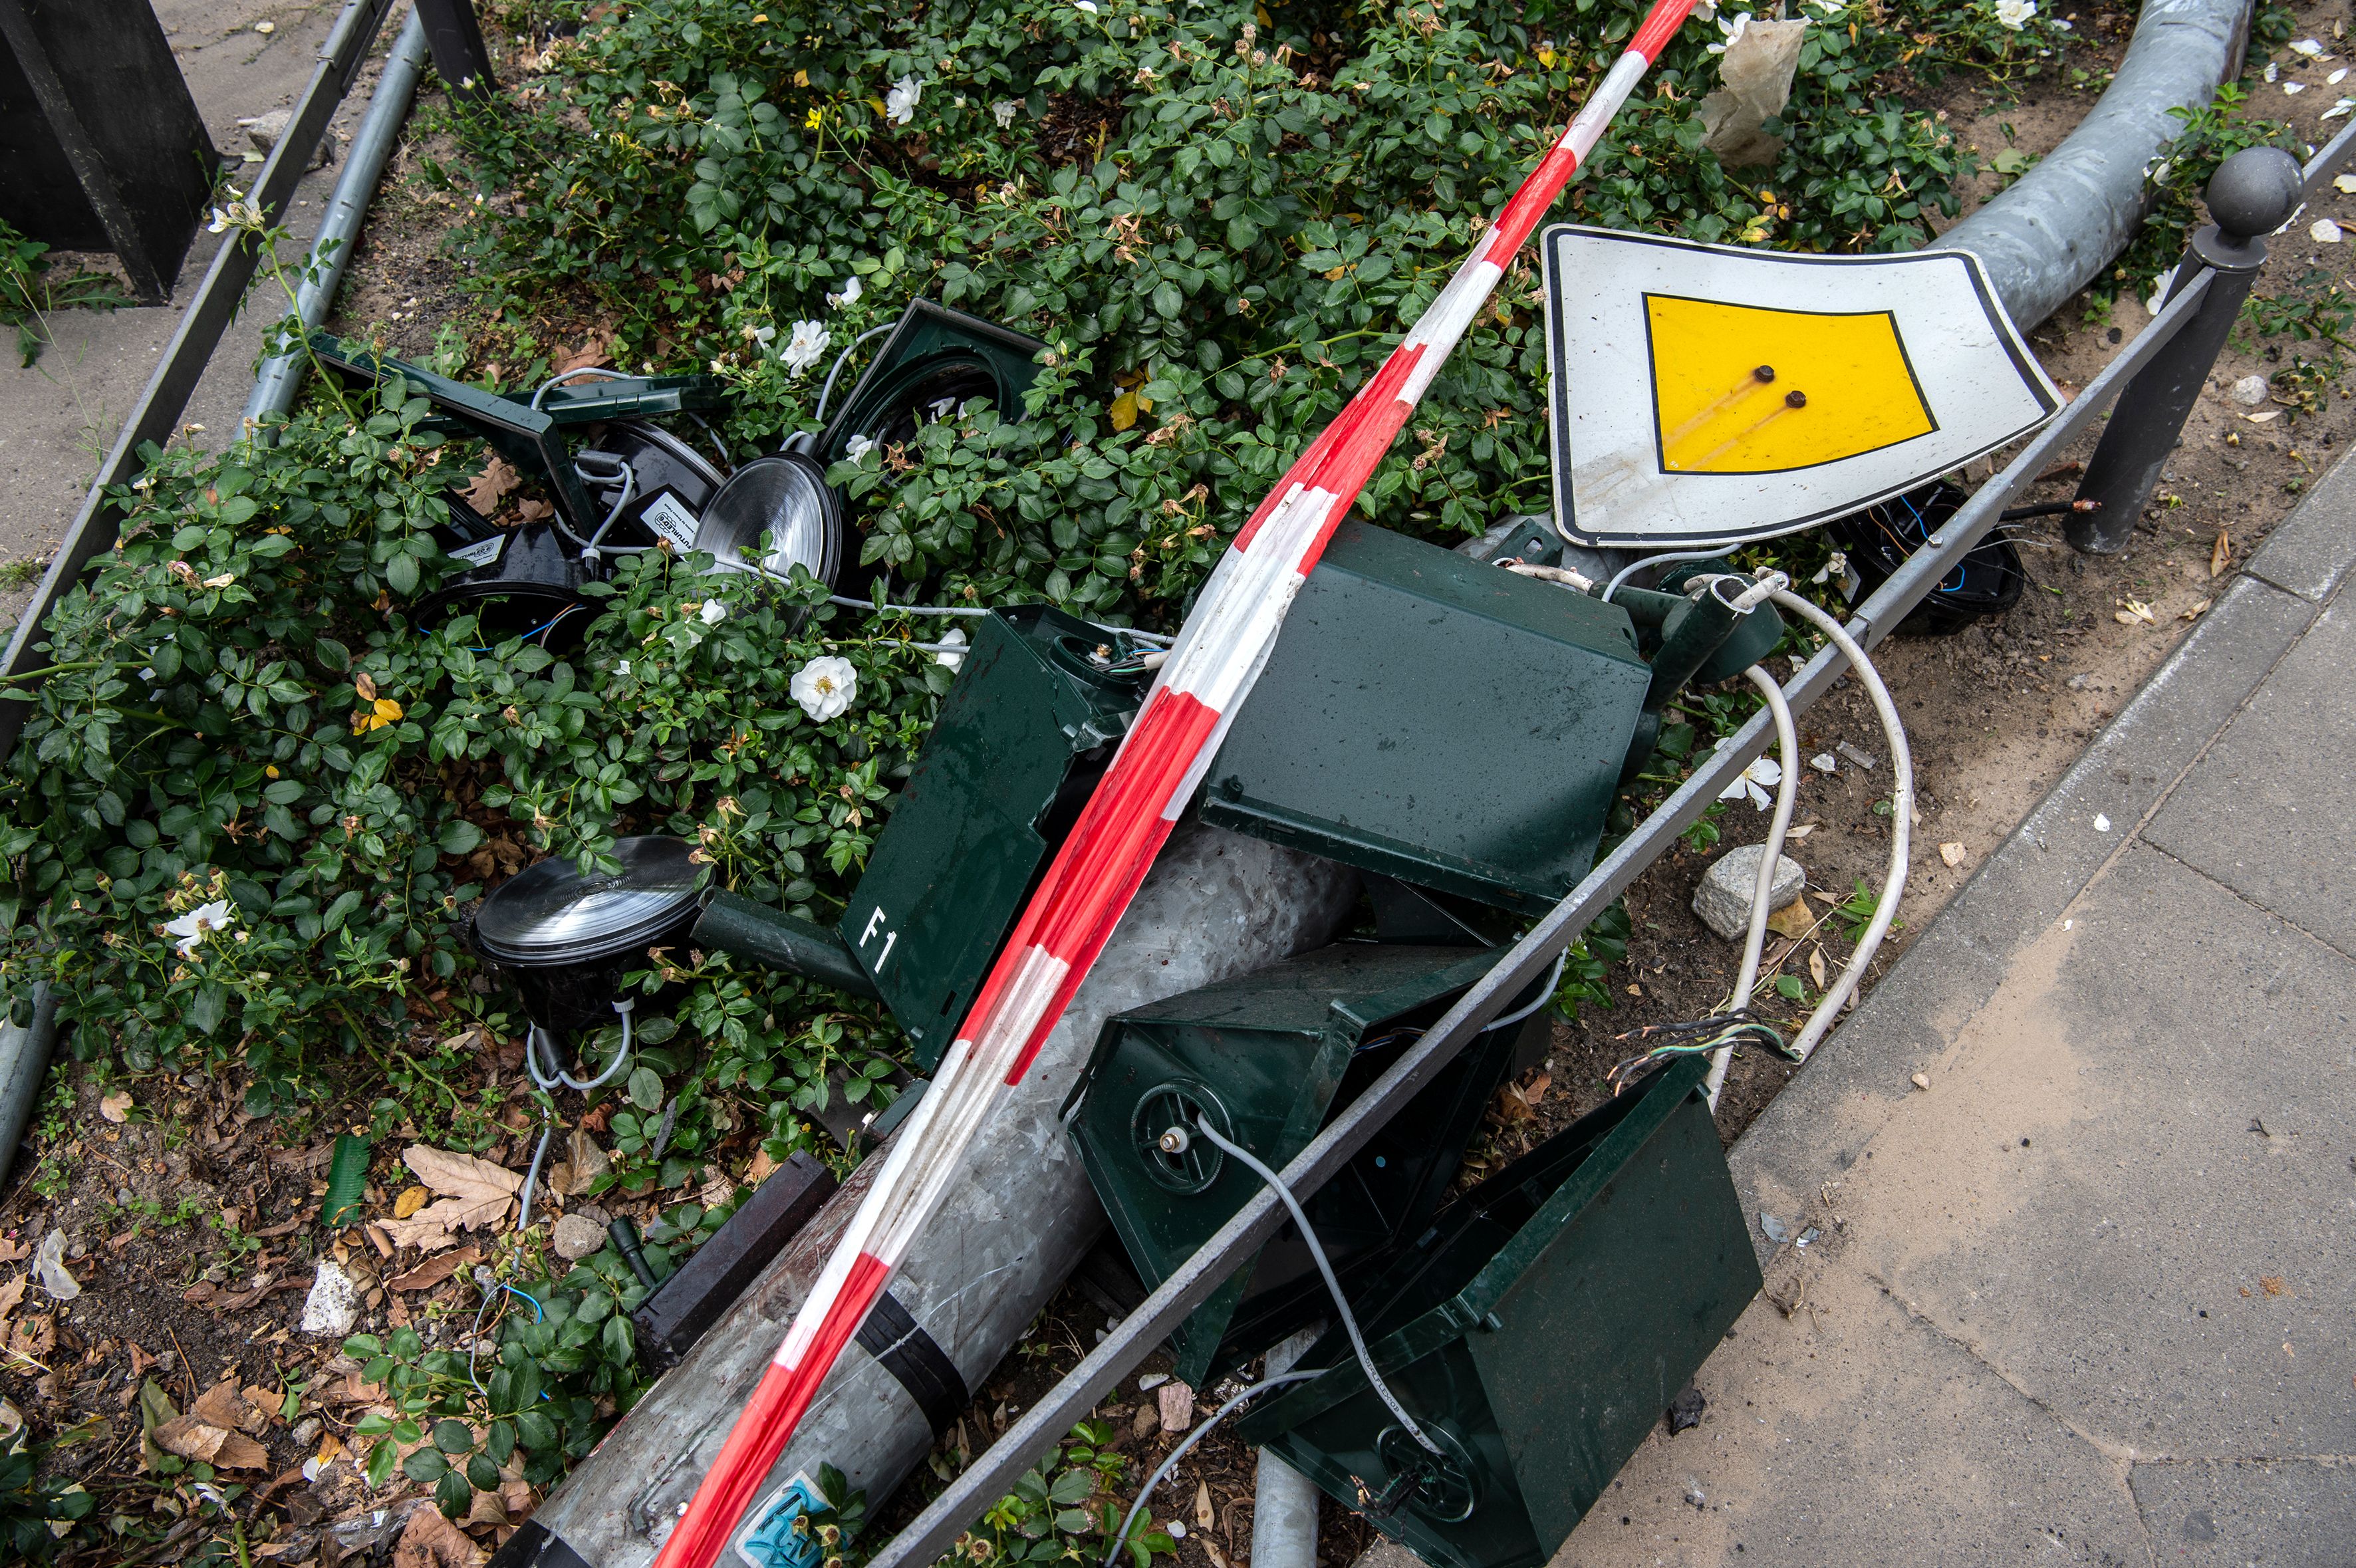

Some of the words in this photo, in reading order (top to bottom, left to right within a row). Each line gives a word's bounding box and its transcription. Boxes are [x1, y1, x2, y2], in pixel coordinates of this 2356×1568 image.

[664, 521, 692, 549] FUTURLED
[458, 549, 485, 560] UTURLED
[859, 906, 896, 974] F1
